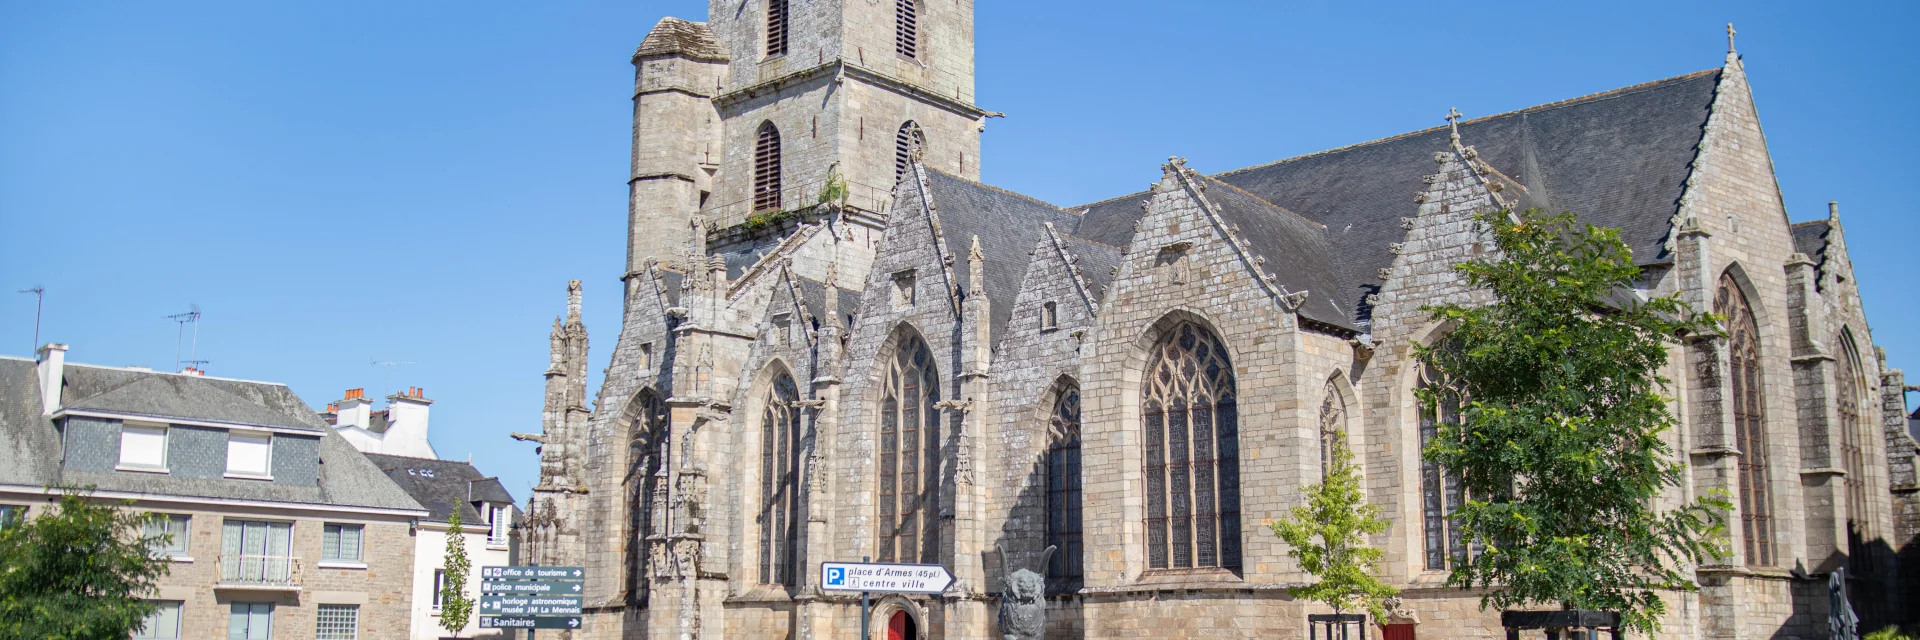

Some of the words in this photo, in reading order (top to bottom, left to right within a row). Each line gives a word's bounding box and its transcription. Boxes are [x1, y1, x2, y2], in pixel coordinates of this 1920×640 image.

[828, 569, 840, 583] P
[848, 568, 872, 577] place
[515, 584, 550, 592] municipale
[863, 579, 896, 588] centre
[902, 580, 925, 588] ville
[532, 598, 578, 606] astronomique
[494, 618, 535, 627] Sanitaires
